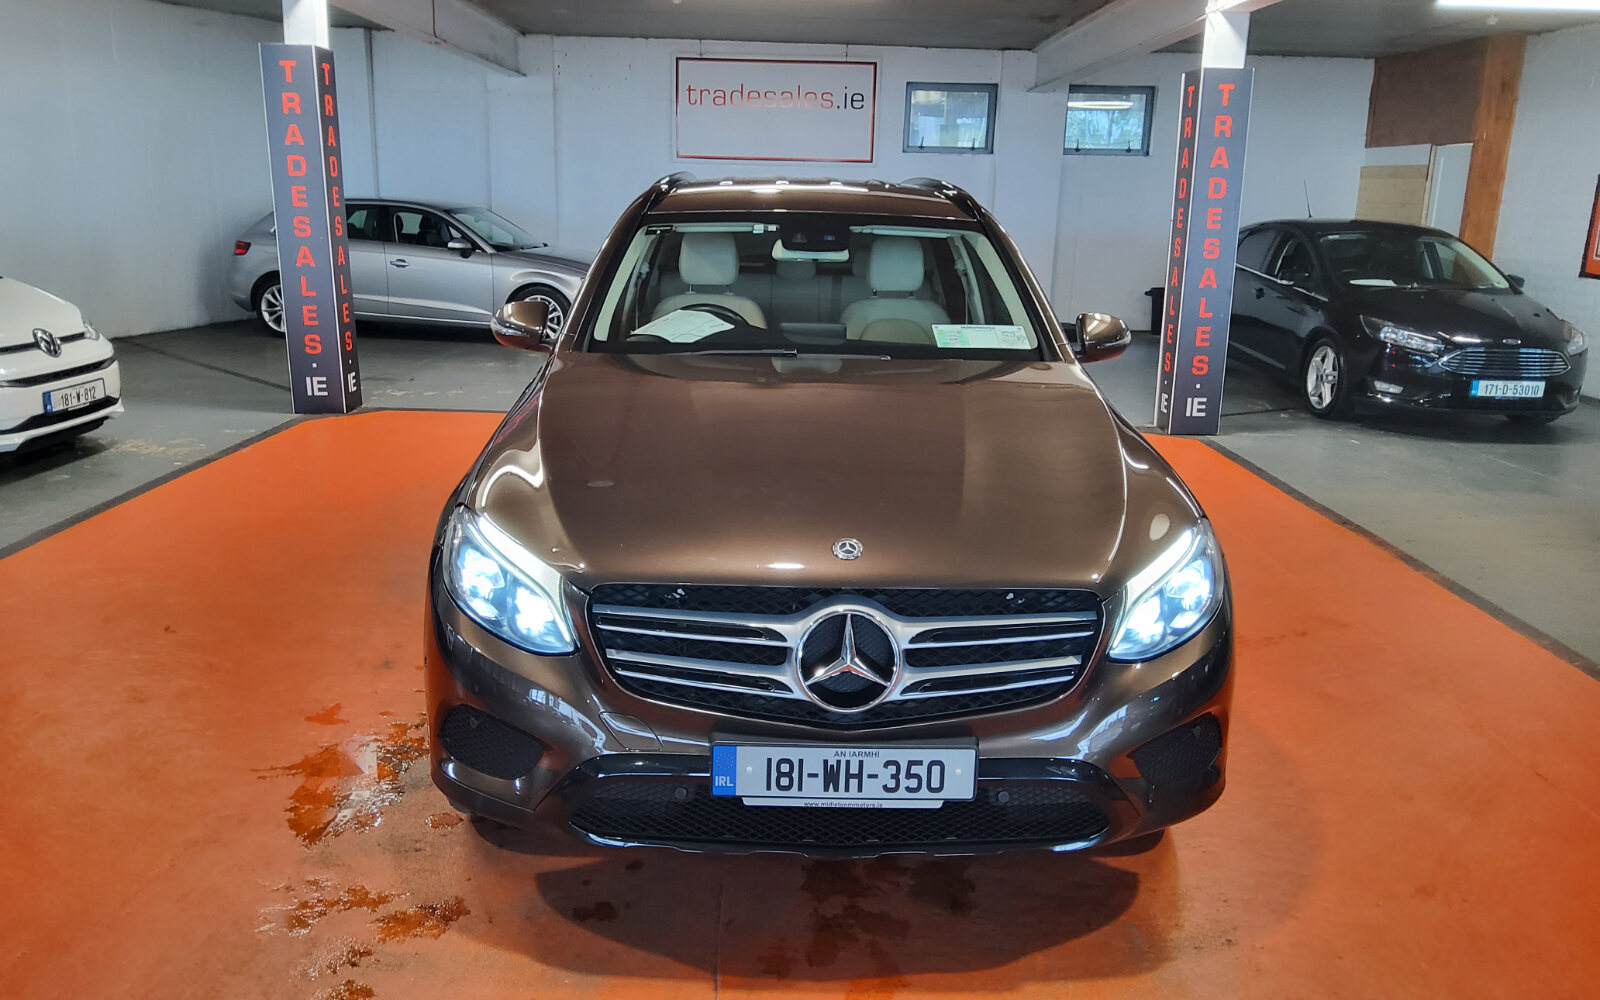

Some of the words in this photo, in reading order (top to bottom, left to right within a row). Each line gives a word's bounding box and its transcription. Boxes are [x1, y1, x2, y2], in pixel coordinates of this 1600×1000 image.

[686, 83, 865, 110] tradesales.ie
[60, 386, 97, 407] 181-W-812
[1484, 384, 1540, 396] 171-D-53010
[833, 750, 847, 758] AN
[714, 775, 735, 787] IRL
[765, 757, 946, 794] 181-WH-350
